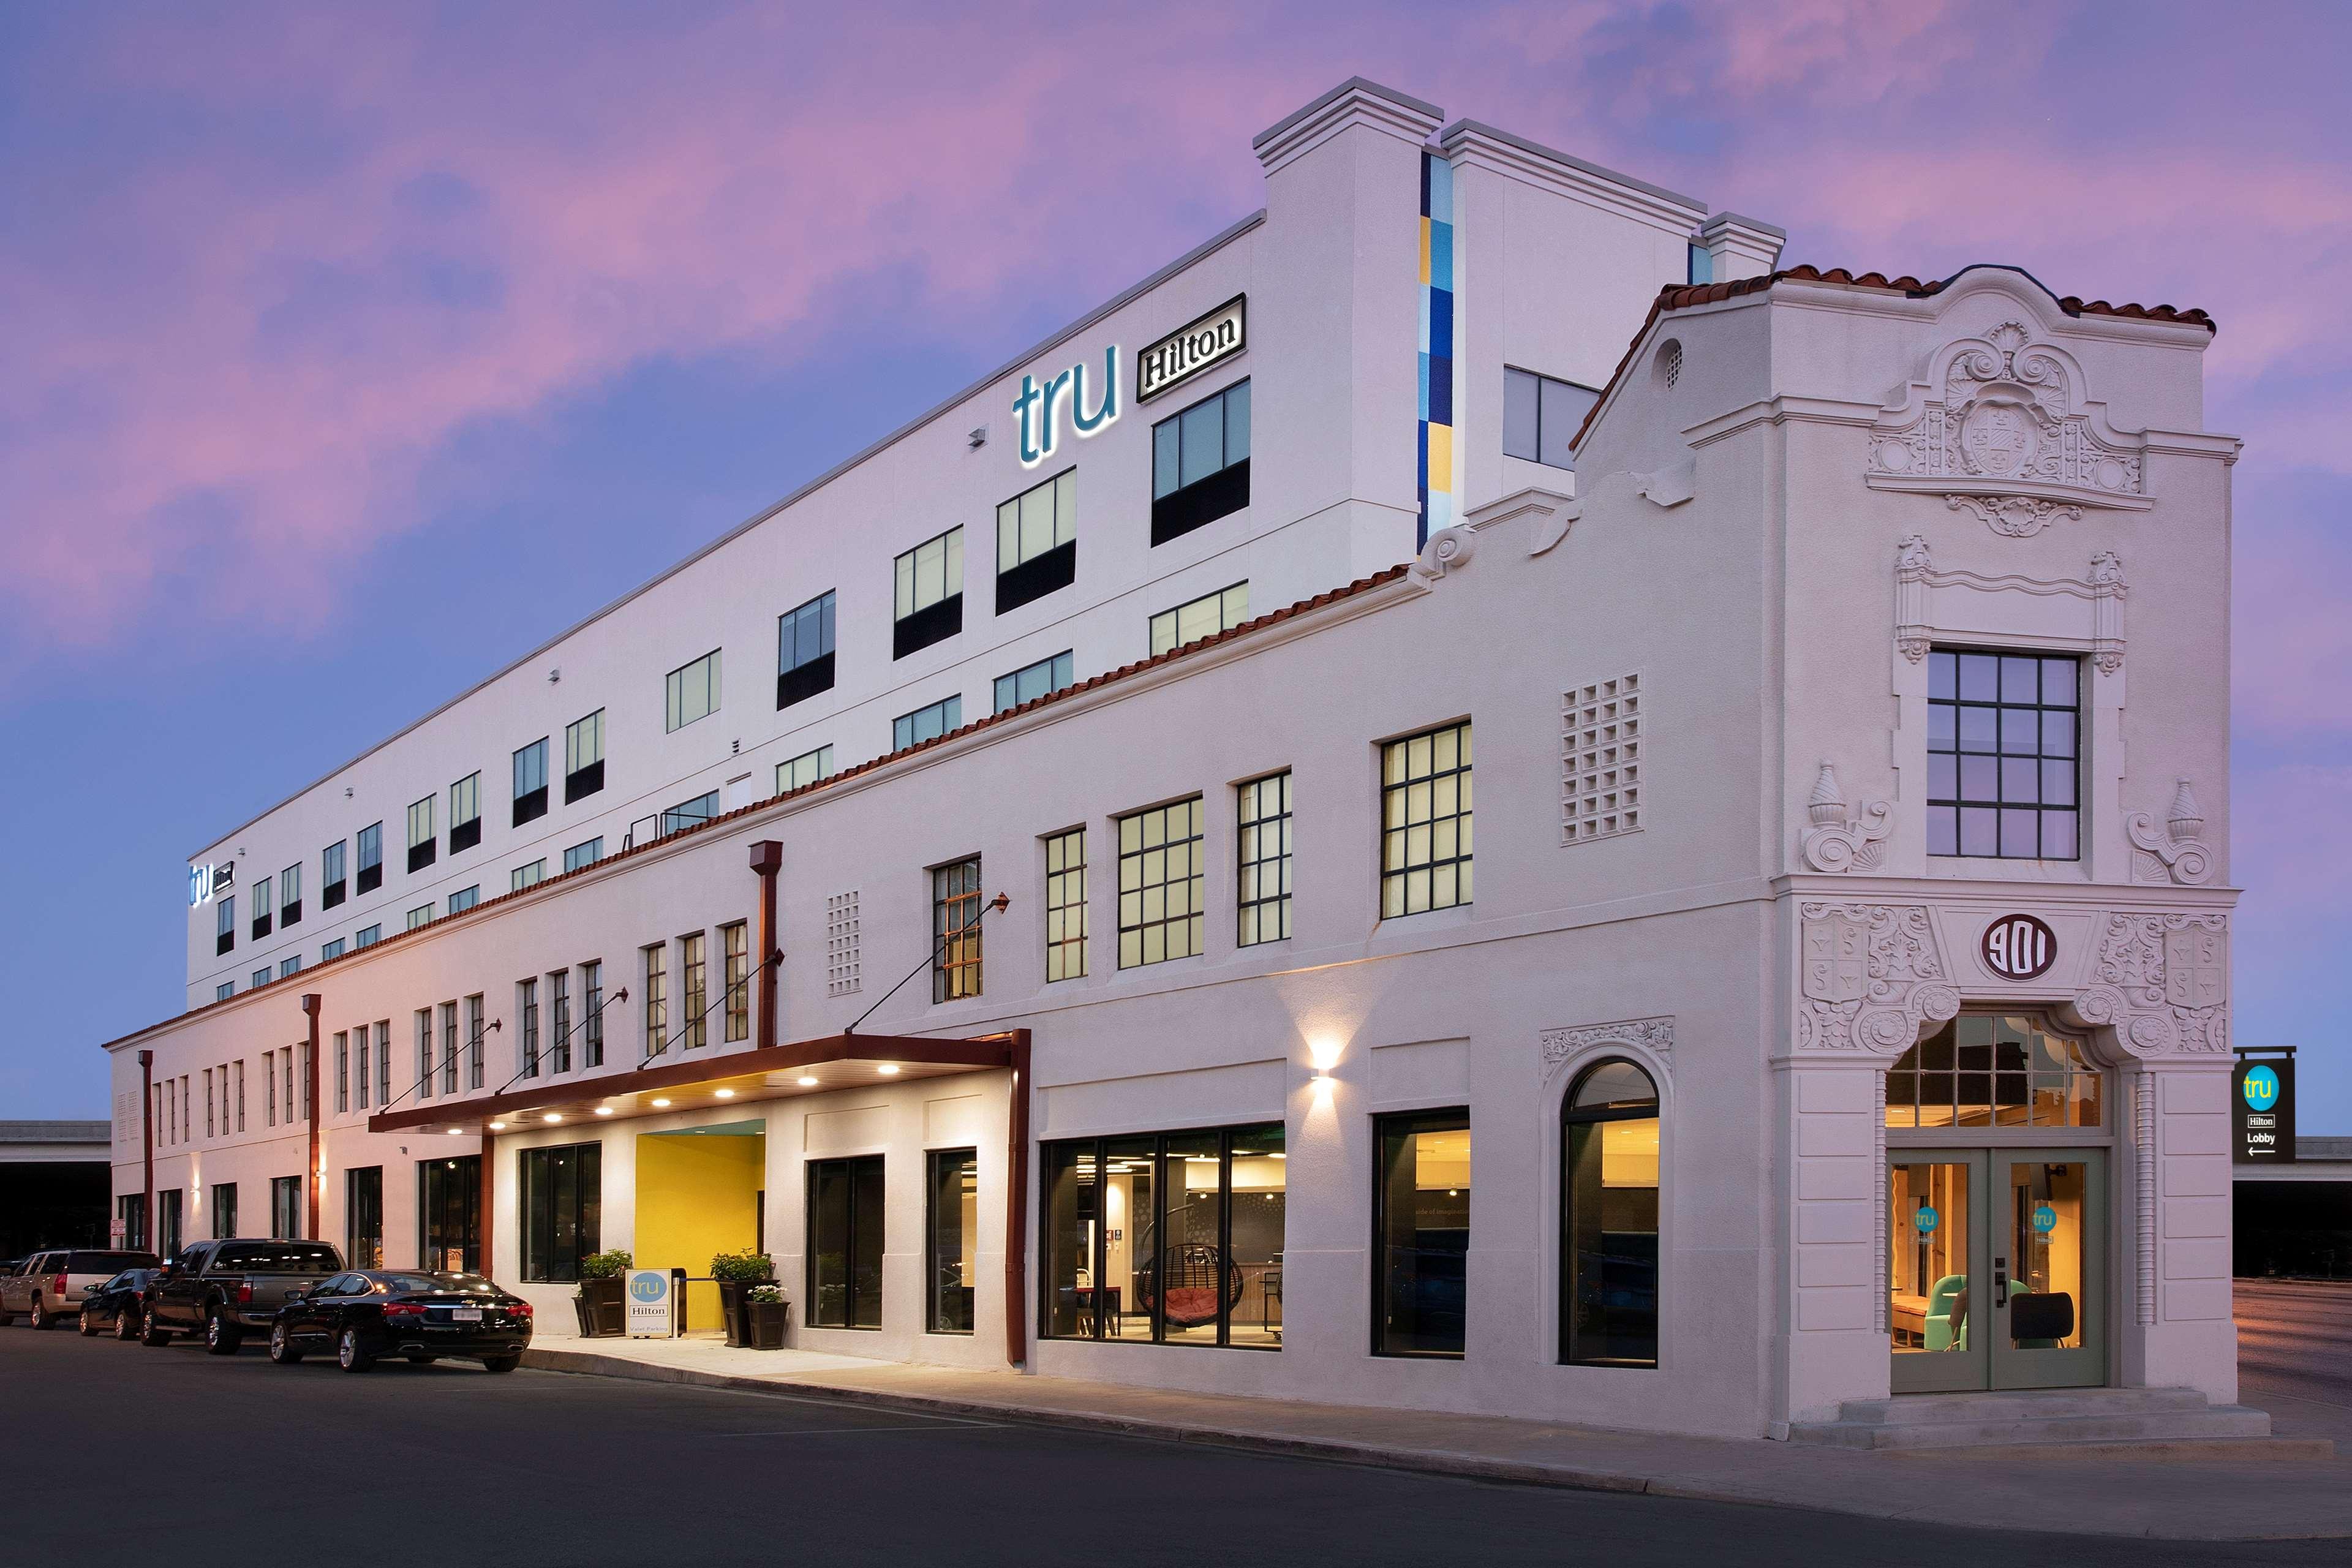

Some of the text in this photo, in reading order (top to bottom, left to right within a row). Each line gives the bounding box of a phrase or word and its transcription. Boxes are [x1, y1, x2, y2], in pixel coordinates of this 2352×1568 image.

[1144, 318, 1235, 388] Hilton
[1012, 345, 1117, 463] tru
[1989, 921, 2046, 974] 901
[2244, 1076, 2271, 1098] tru
[2250, 1117, 2273, 1126] Hilton
[2247, 1133, 2275, 1145] Lobby
[1915, 1213, 1934, 1226] tru
[2033, 1213, 2052, 1226] tru
[631, 1280, 658, 1294] tru
